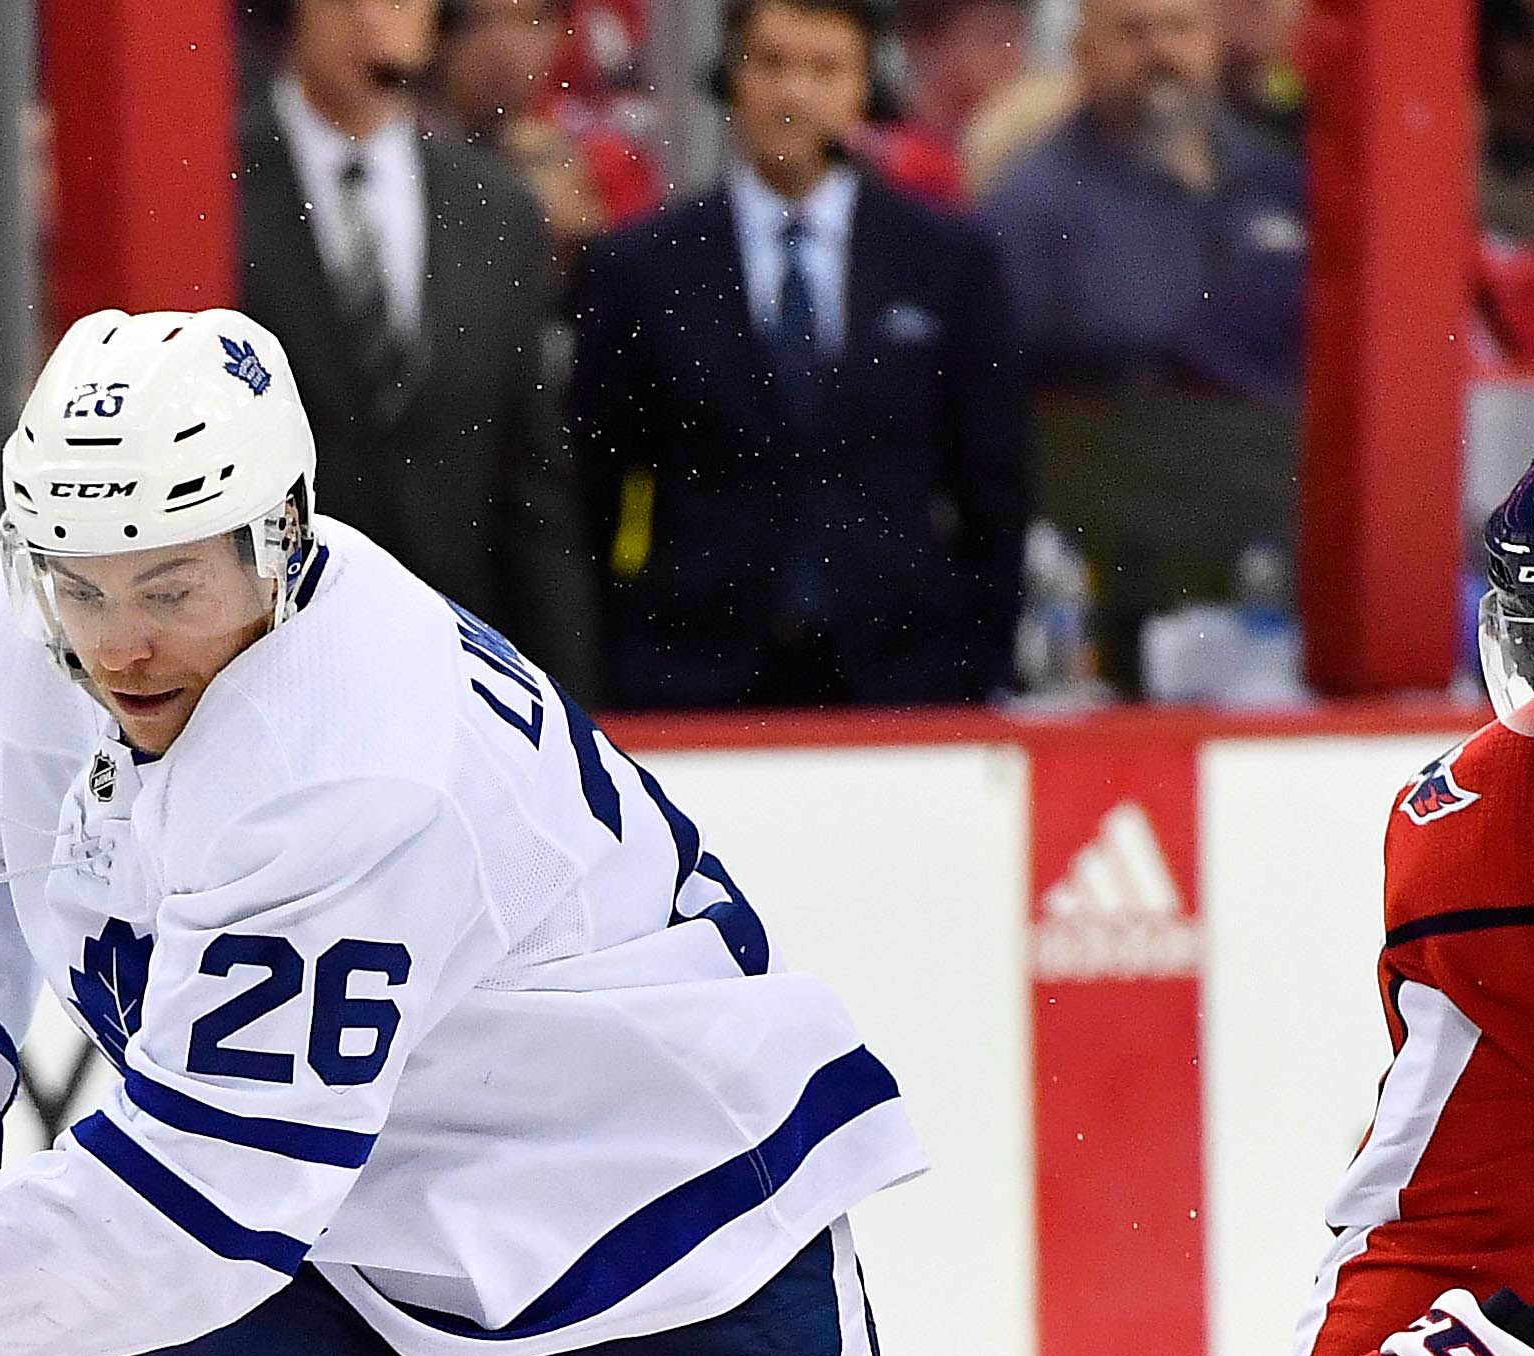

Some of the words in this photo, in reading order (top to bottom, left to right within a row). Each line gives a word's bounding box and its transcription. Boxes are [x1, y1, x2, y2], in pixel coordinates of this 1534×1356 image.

[64, 382, 130, 418] 26
[50, 481, 138, 498] CCM
[186, 932, 413, 1087] 26
